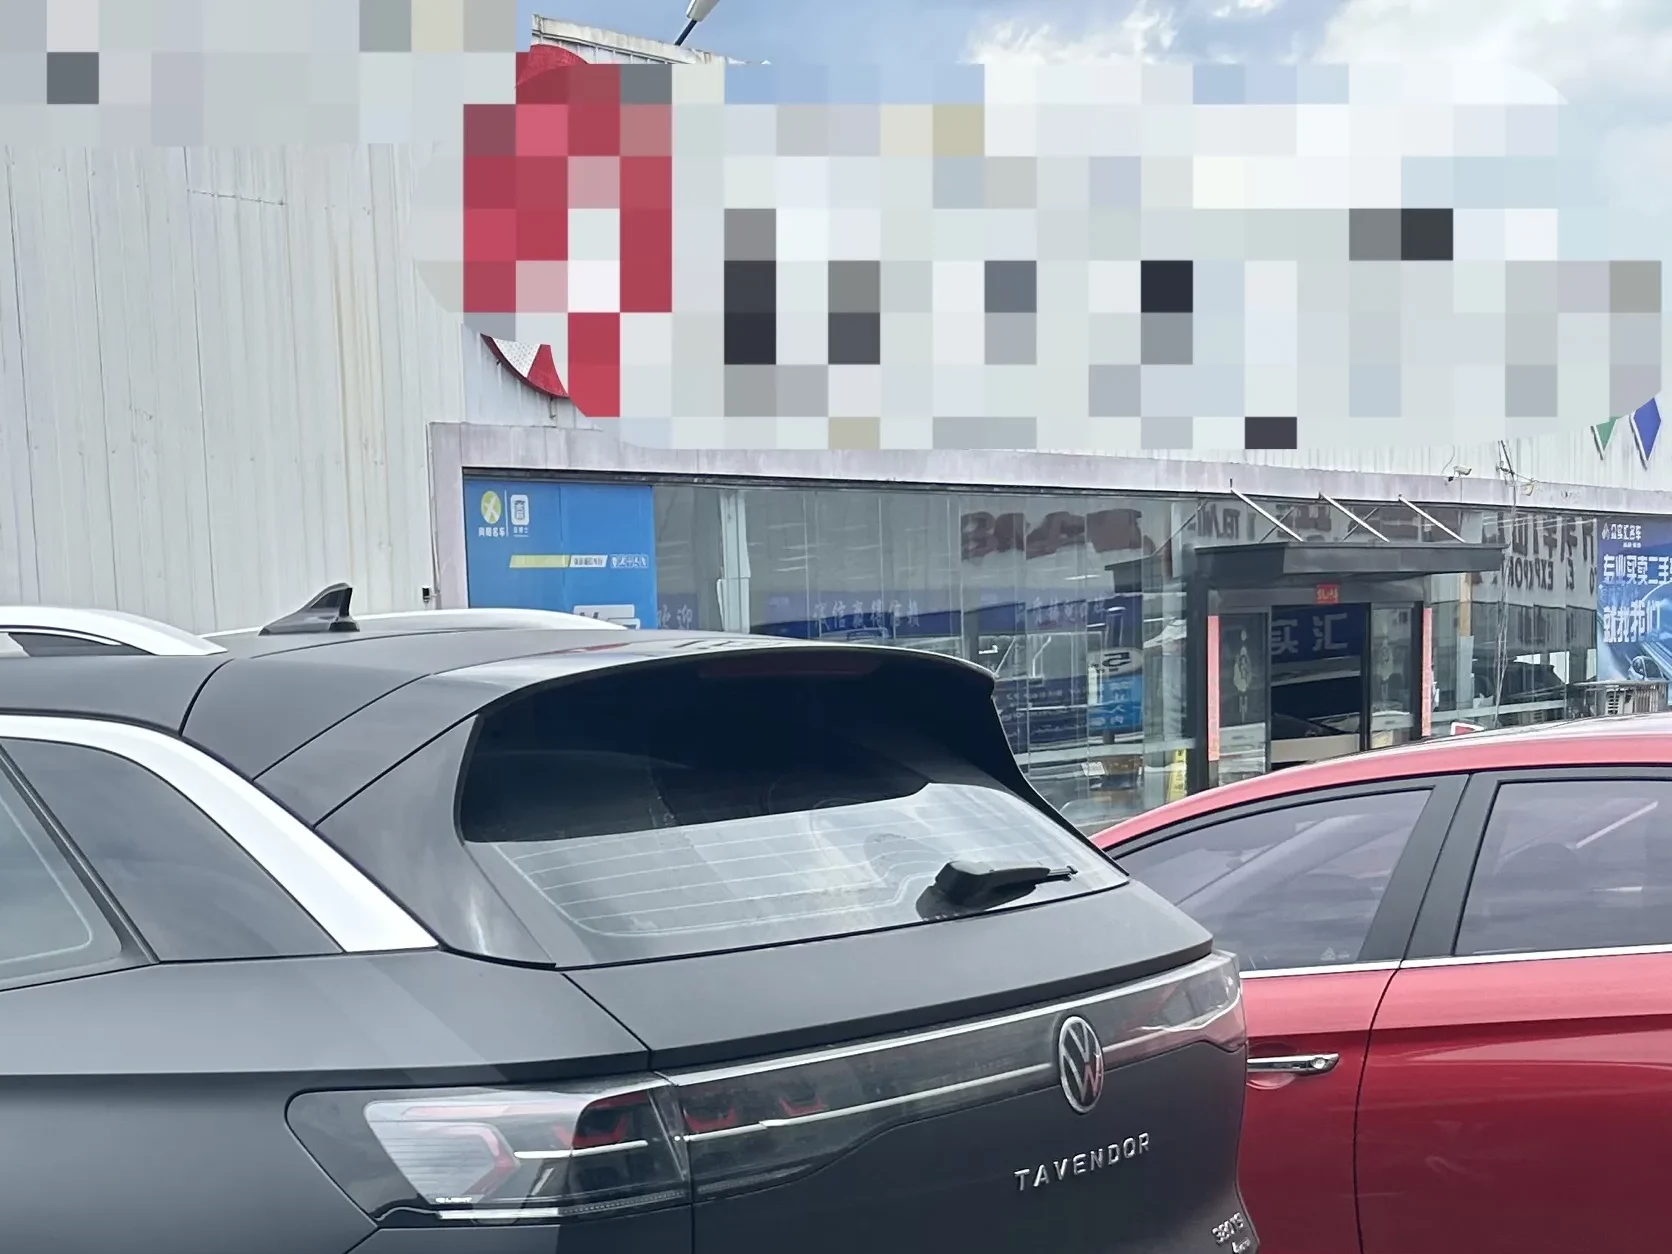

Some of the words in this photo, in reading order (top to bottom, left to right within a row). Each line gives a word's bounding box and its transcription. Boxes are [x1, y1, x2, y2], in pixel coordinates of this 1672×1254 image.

[1602, 553, 1672, 585] 专业买卖二手
[1603, 599, 1661, 643] 就找我们
[1014, 1132, 1151, 1191] TAVENDOR
